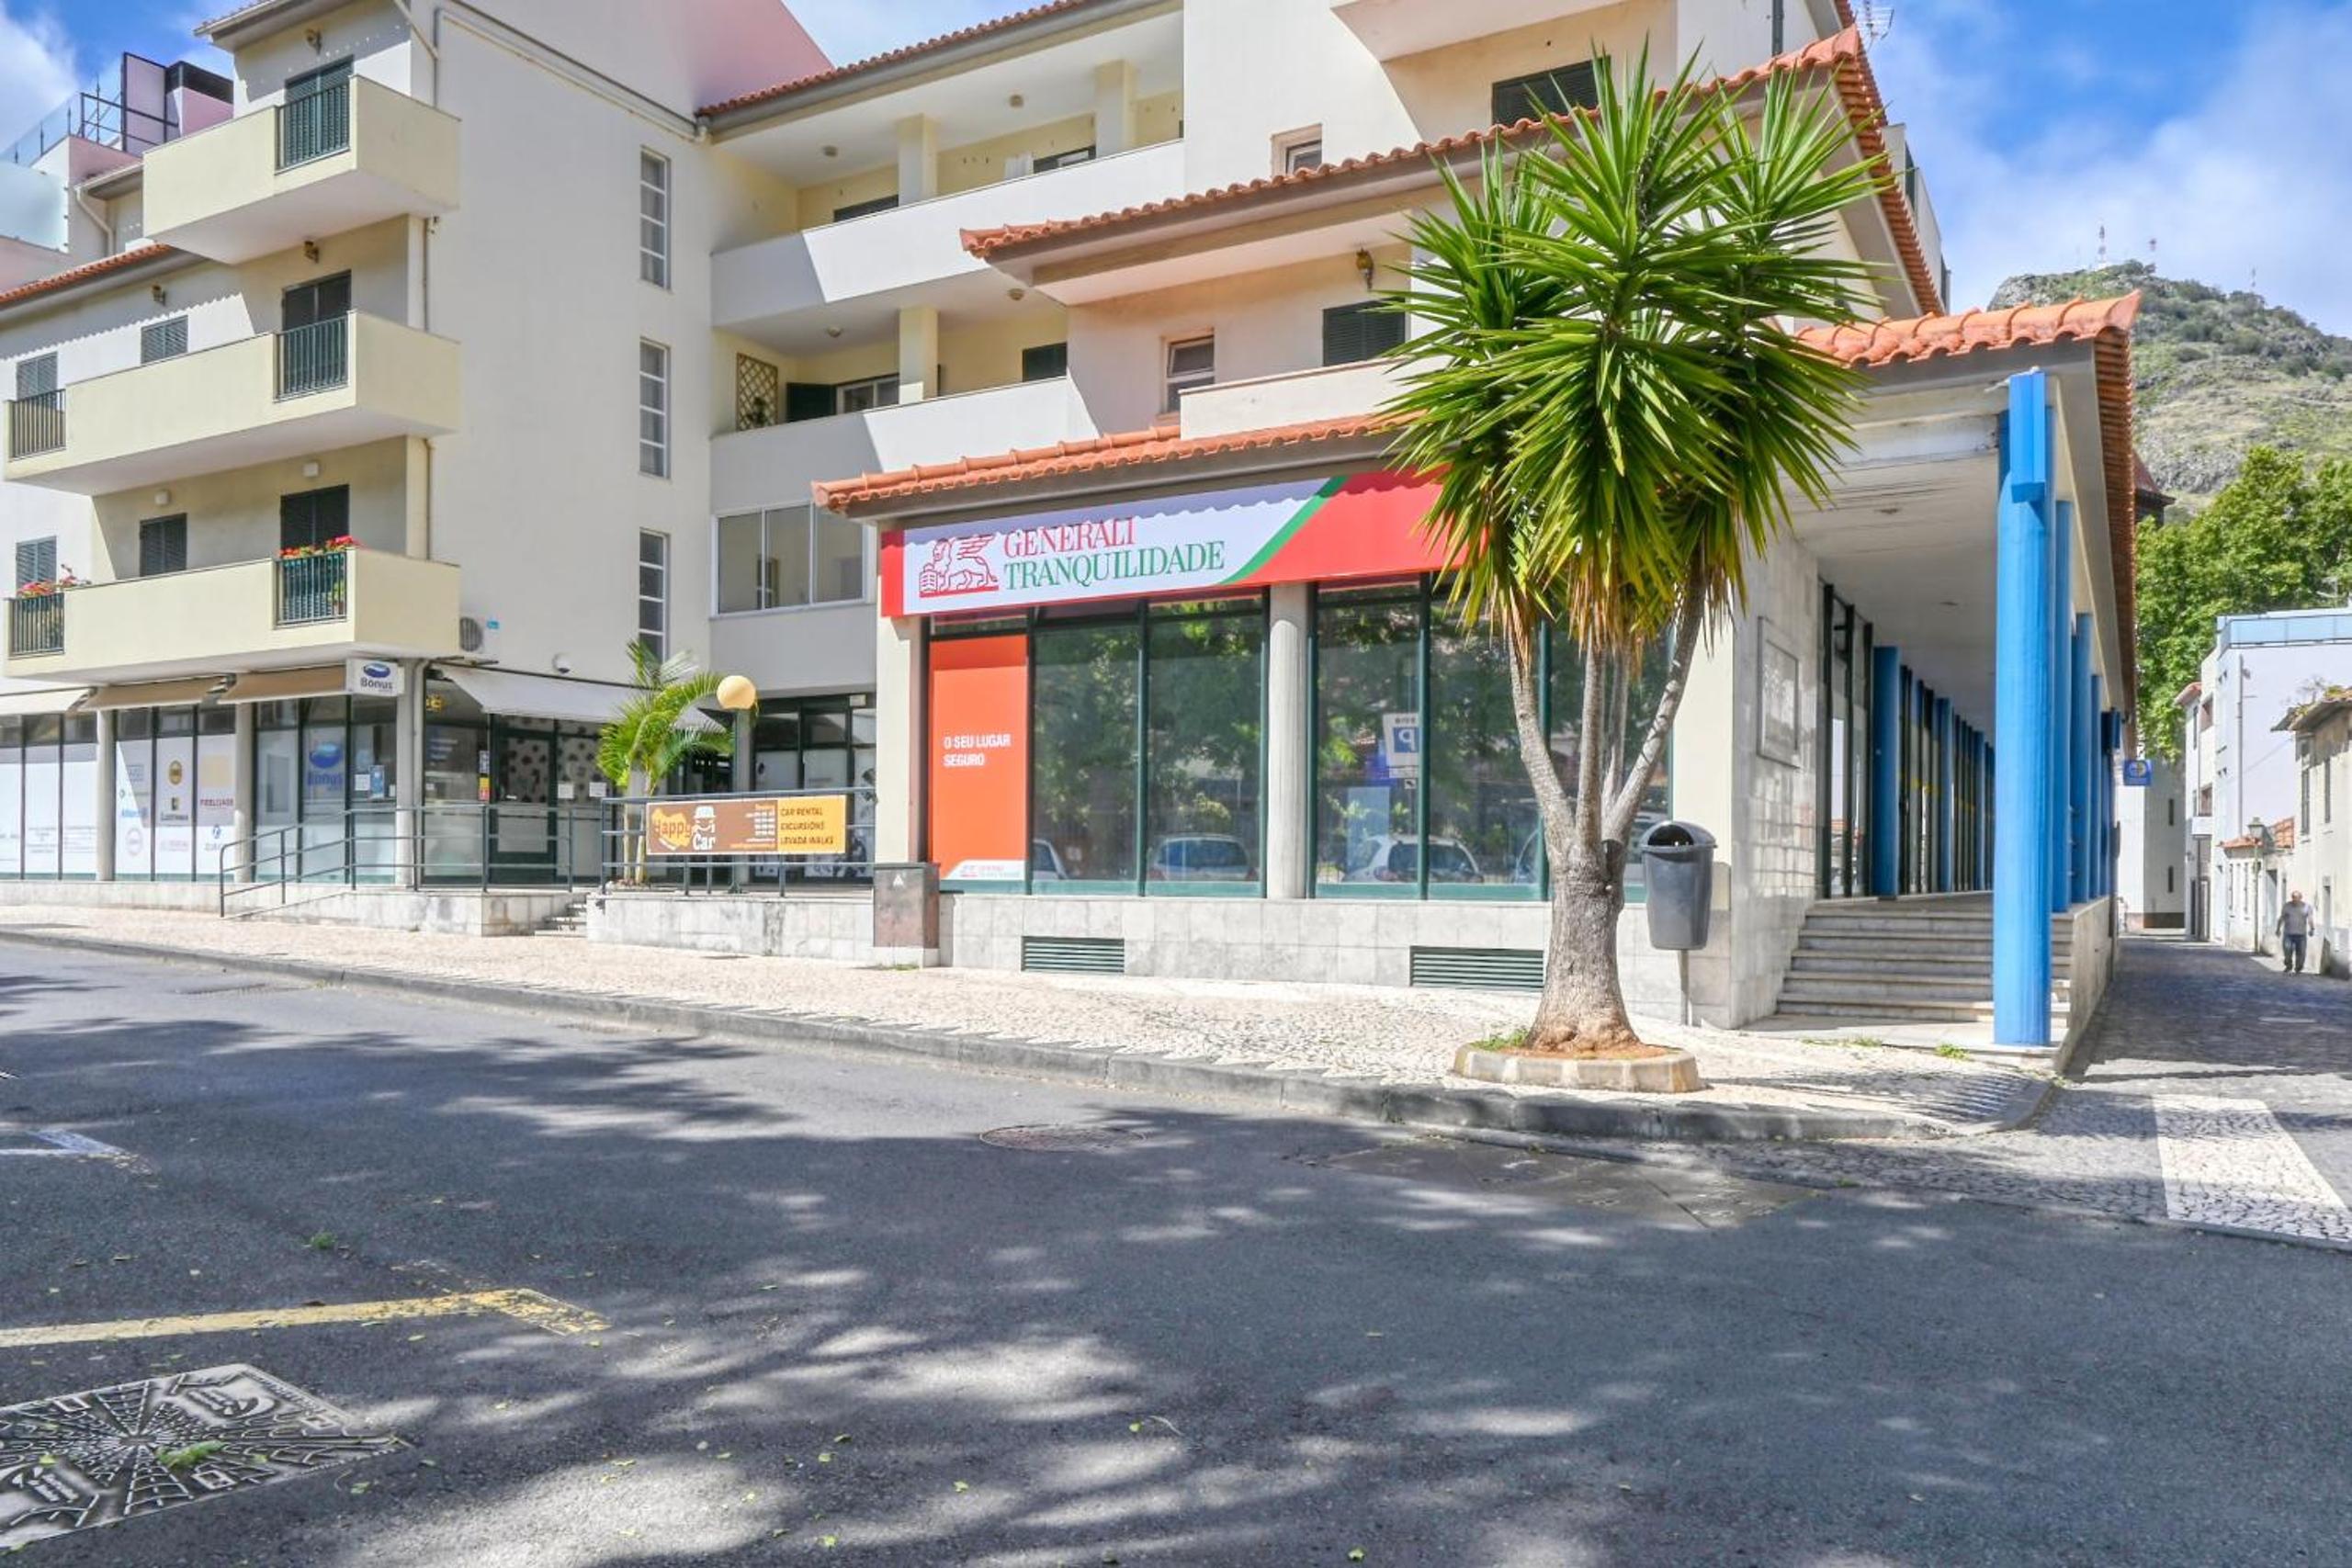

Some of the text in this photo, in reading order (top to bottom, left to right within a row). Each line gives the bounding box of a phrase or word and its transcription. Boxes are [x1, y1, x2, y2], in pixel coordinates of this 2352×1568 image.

[1003, 515, 1136, 558] GENERALI
[1003, 540, 1226, 591] TRANQUILIDADE
[360, 676, 393, 690] Bonus
[944, 733, 1012, 750] O SEU LUGAR
[943, 753, 986, 767] SEGURO
[780, 808, 796, 817] CAR
[797, 807, 823, 816] RENTAL
[653, 818, 692, 839] Happy
[692, 833, 716, 851] Car
